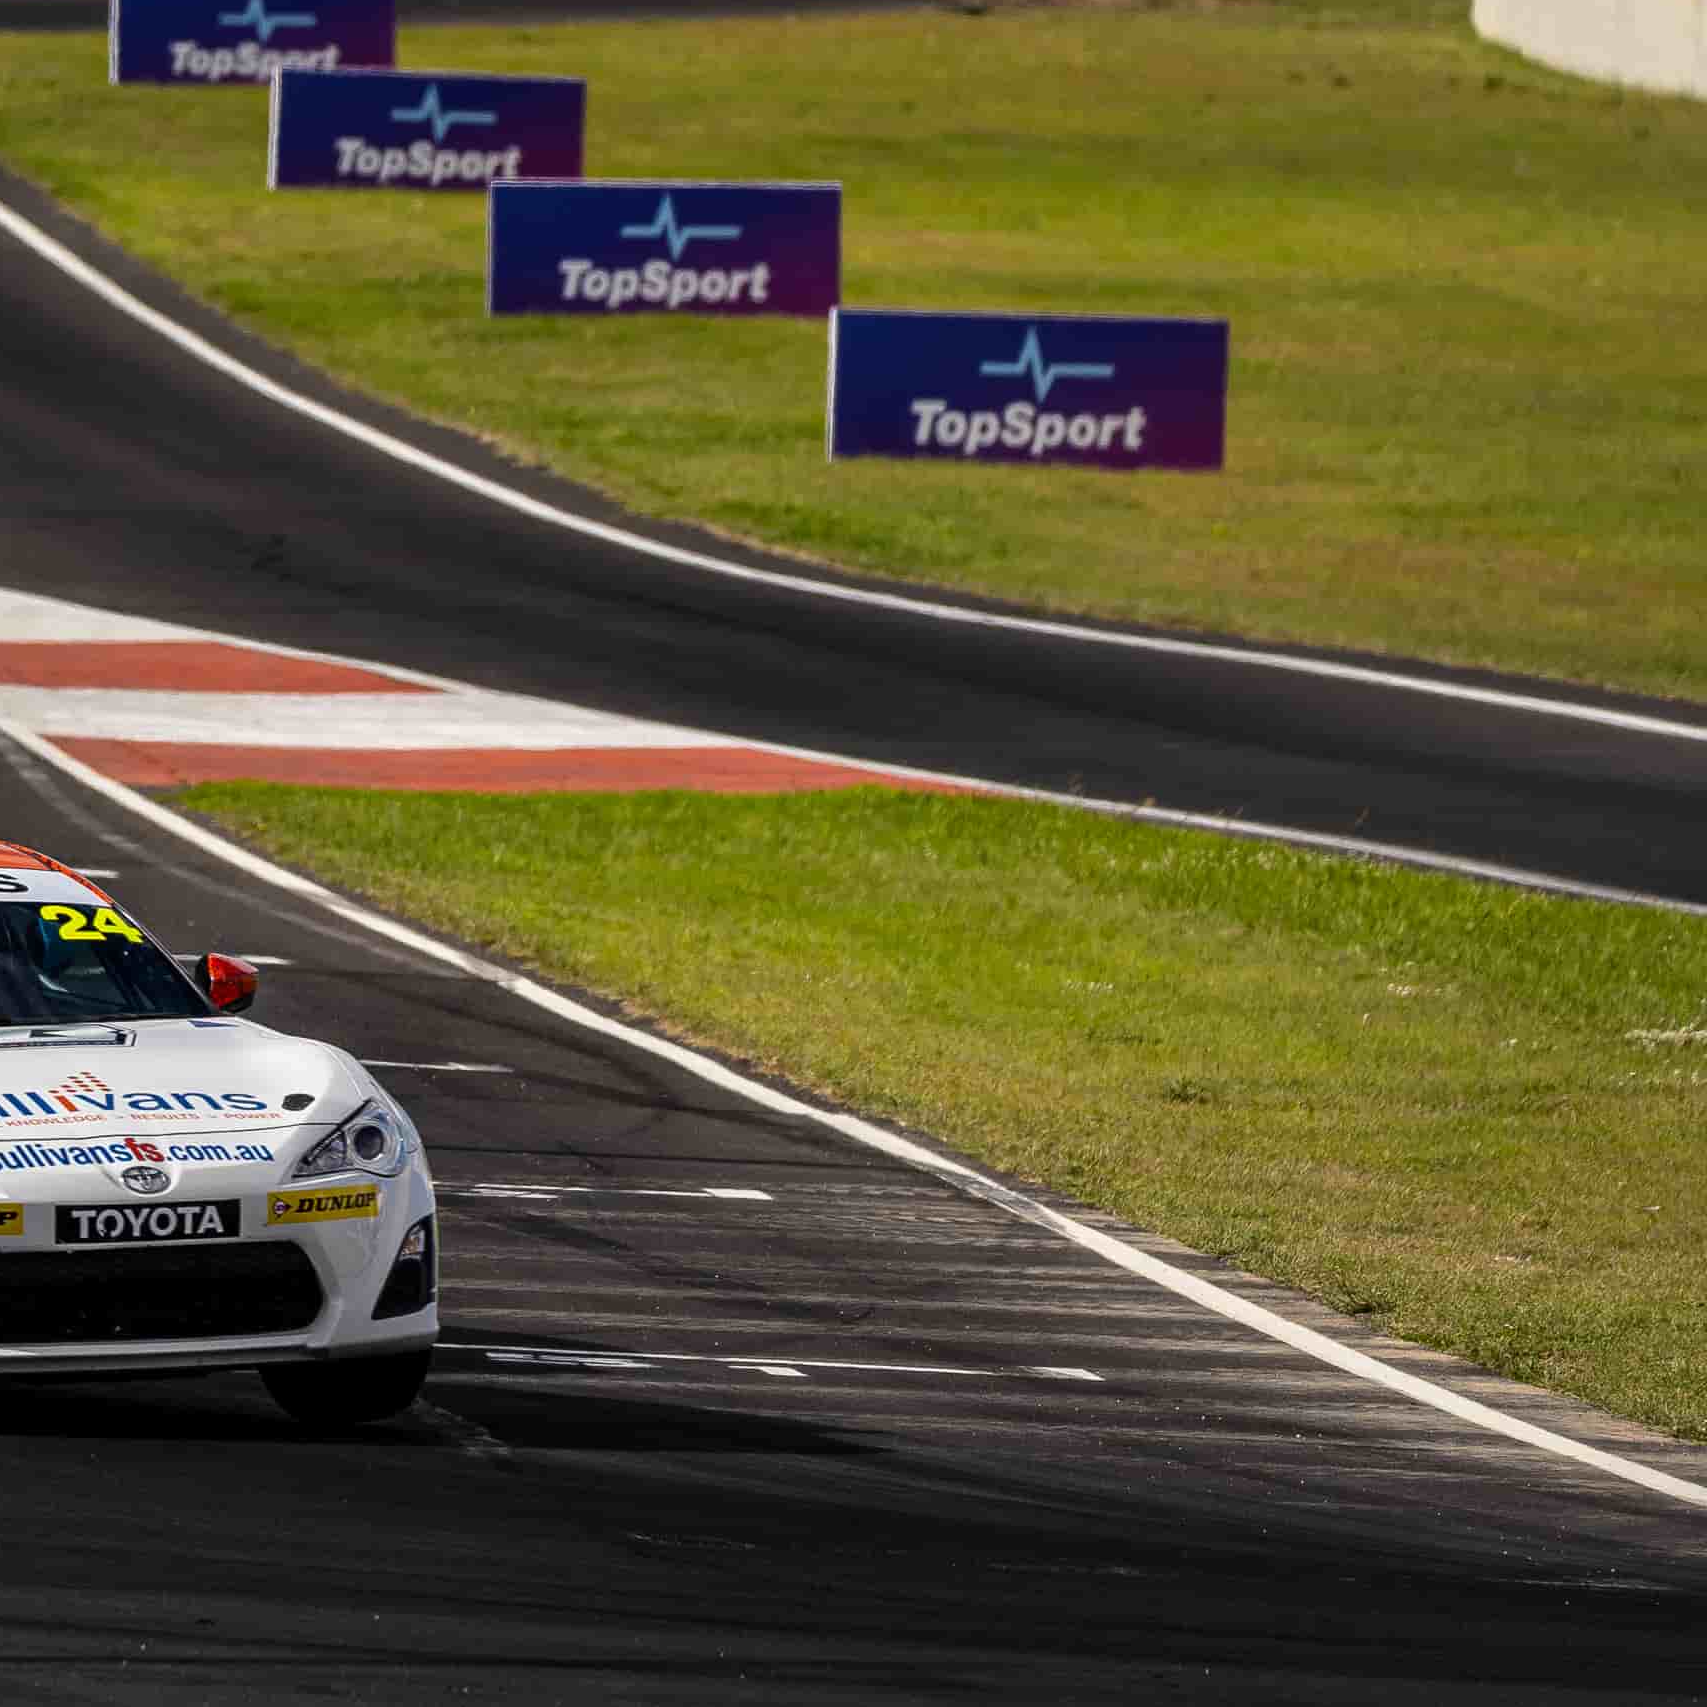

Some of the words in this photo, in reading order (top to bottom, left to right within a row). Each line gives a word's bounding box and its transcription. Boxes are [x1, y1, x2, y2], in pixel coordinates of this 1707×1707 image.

[169, 40, 341, 78] TopSport
[334, 137, 521, 182] TopSport
[558, 260, 770, 309] TopSport
[910, 399, 1146, 455] TopSport
[38, 904, 144, 944] 24
[71, 1204, 225, 1241] TOYOTA
[293, 1191, 378, 1219] DUNLOP
